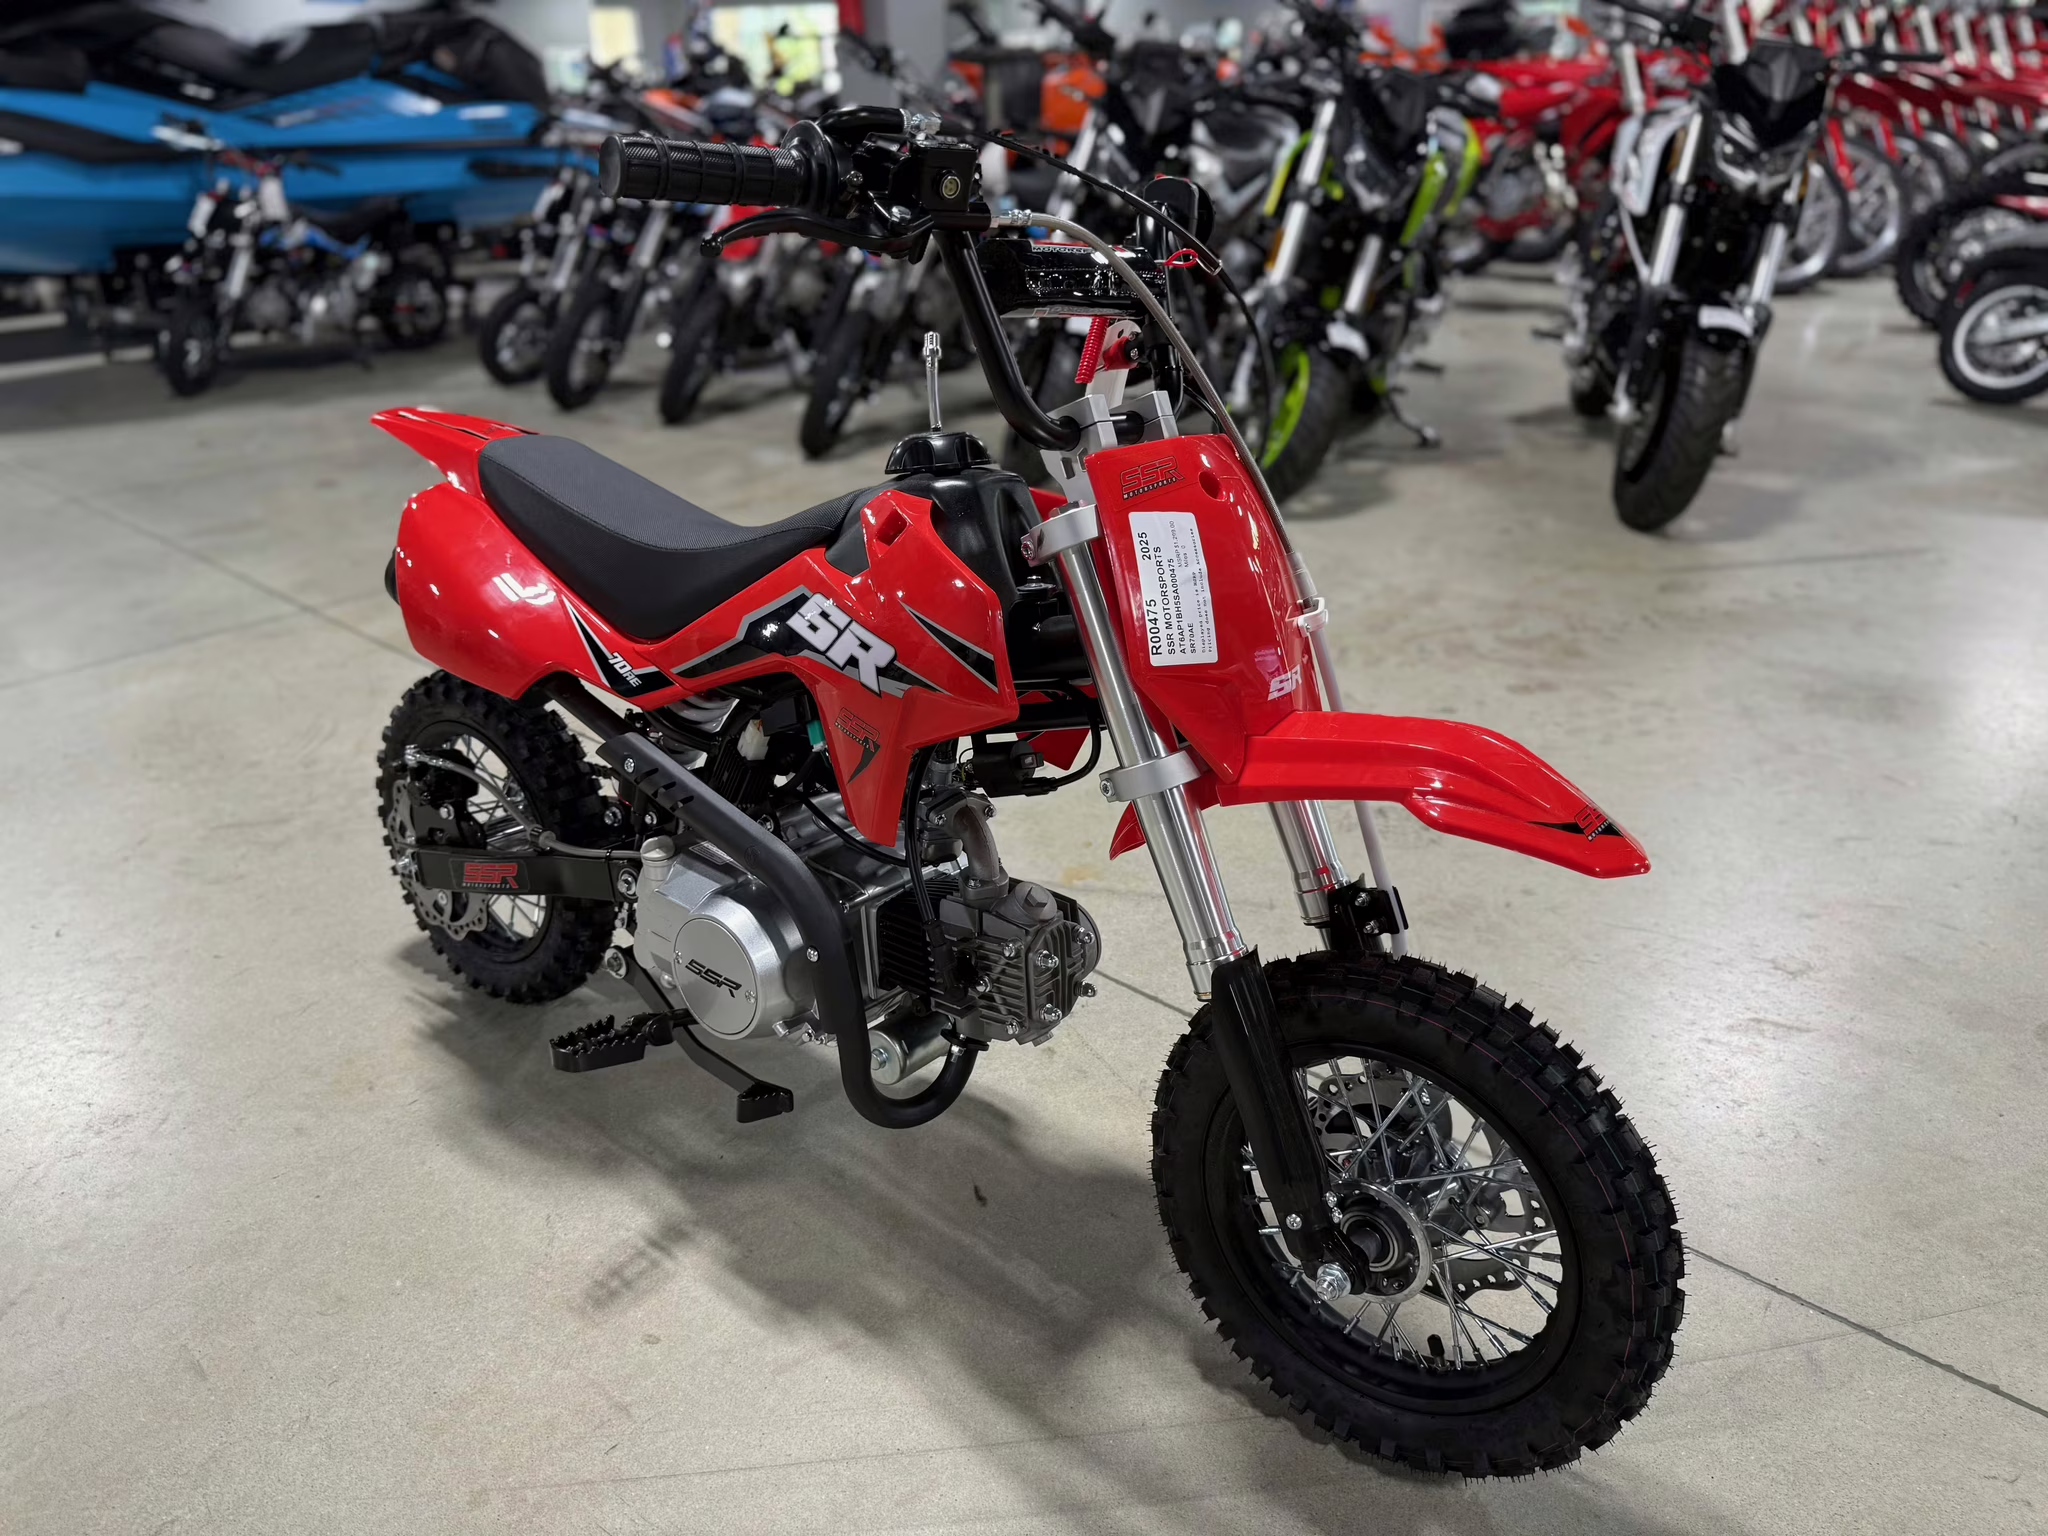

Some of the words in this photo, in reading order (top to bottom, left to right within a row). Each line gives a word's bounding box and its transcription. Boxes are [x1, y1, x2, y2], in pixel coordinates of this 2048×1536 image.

[1120, 456, 1185, 494] SSR
[1123, 477, 1178, 500] MOTORSPORTS
[1137, 532, 1151, 560] 2025
[1175, 549, 1183, 568] MSRP
[1153, 546, 1173, 630] MOTORSPORTS
[1167, 558, 1187, 655] AT6AP1BH5SA000475
[1145, 599, 1162, 656] R00475
[1166, 633, 1176, 655] SSR
[1187, 622, 1197, 654] SR70AE
[837, 707, 880, 753] SSR
[463, 862, 519, 889] SSR
[685, 959, 742, 998] SSR
